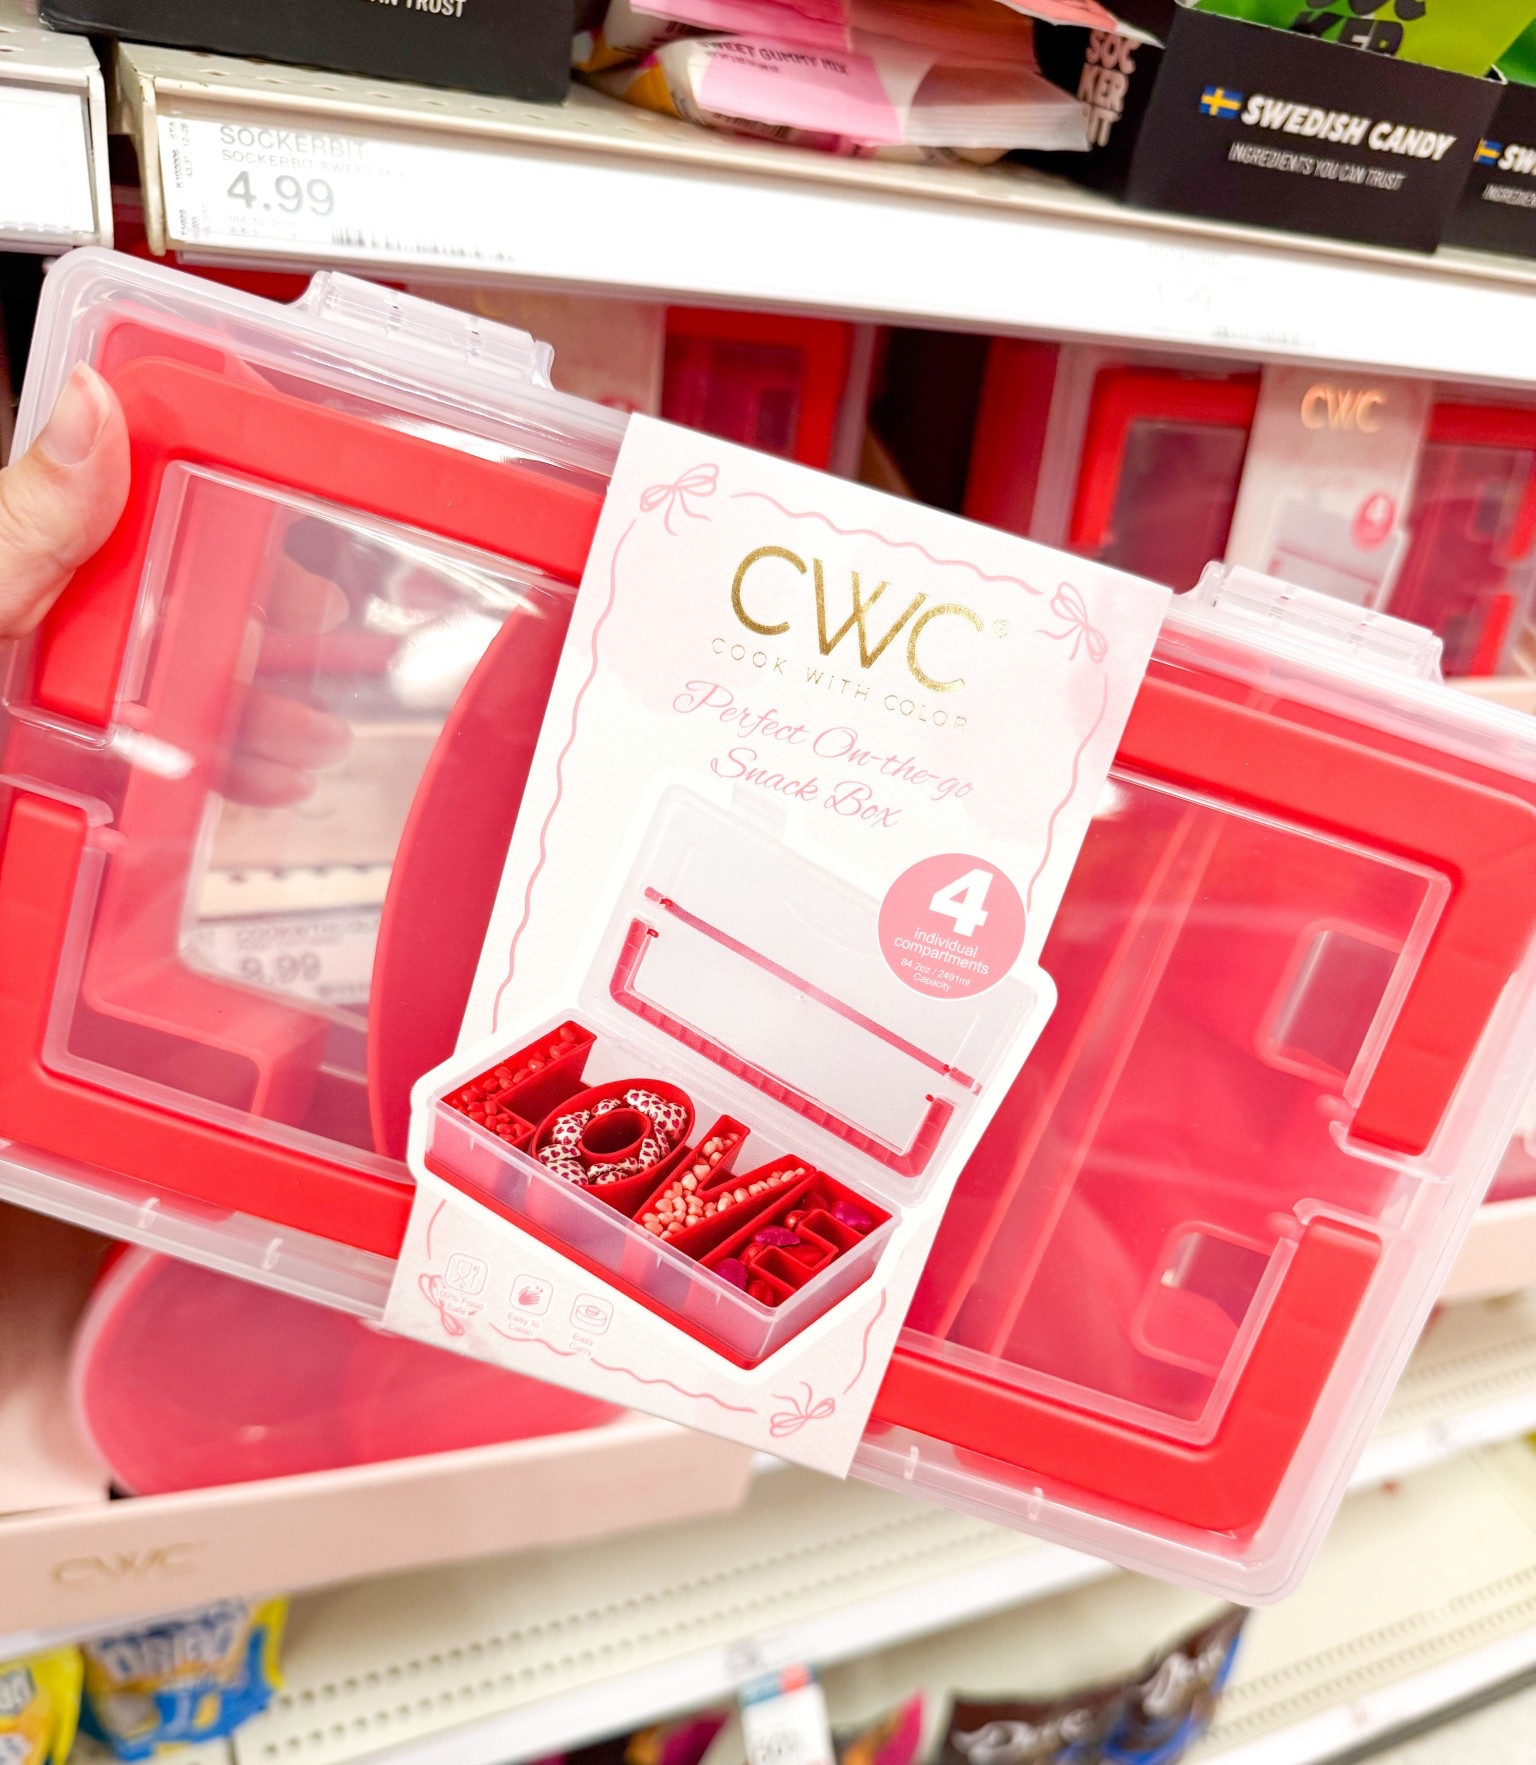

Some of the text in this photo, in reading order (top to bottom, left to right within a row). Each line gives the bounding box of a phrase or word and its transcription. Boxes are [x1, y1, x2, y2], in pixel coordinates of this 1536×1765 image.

[758, 48, 817, 67] GUMMY
[820, 57, 848, 75] MIX
[219, 125, 367, 159] SOCKERBIT
[1241, 94, 1457, 161] SWEDISH CANDY
[222, 149, 314, 171] SOCKERBIT
[1228, 141, 1407, 191] INGREDIENTS YOU CAN TRUST
[1498, 144, 1536, 176] SW
[226, 170, 335, 217] 4.99
[1300, 382, 1387, 433] CWC
[730, 545, 986, 695] CWC
[711, 638, 969, 732] COOK WITH COLOR
[673, 680, 975, 801] Perfect On-the-go
[710, 748, 904, 828] Snack Box
[928, 868, 994, 938] 4
[894, 937, 990, 975] compartments
[913, 928, 979, 958] individual
[900, 958, 931, 975] 84.2oz
[937, 969, 971, 987] 2491ml
[913, 973, 952, 993] Capacity
[435, 1288, 485, 1312] 100% Food
[447, 1303, 467, 1316] Safe
[507, 1311, 541, 1328] Easy to
[508, 1322, 534, 1337] Clean
[569, 1341, 594, 1358] Carry
[572, 1332, 596, 1347] Easy
